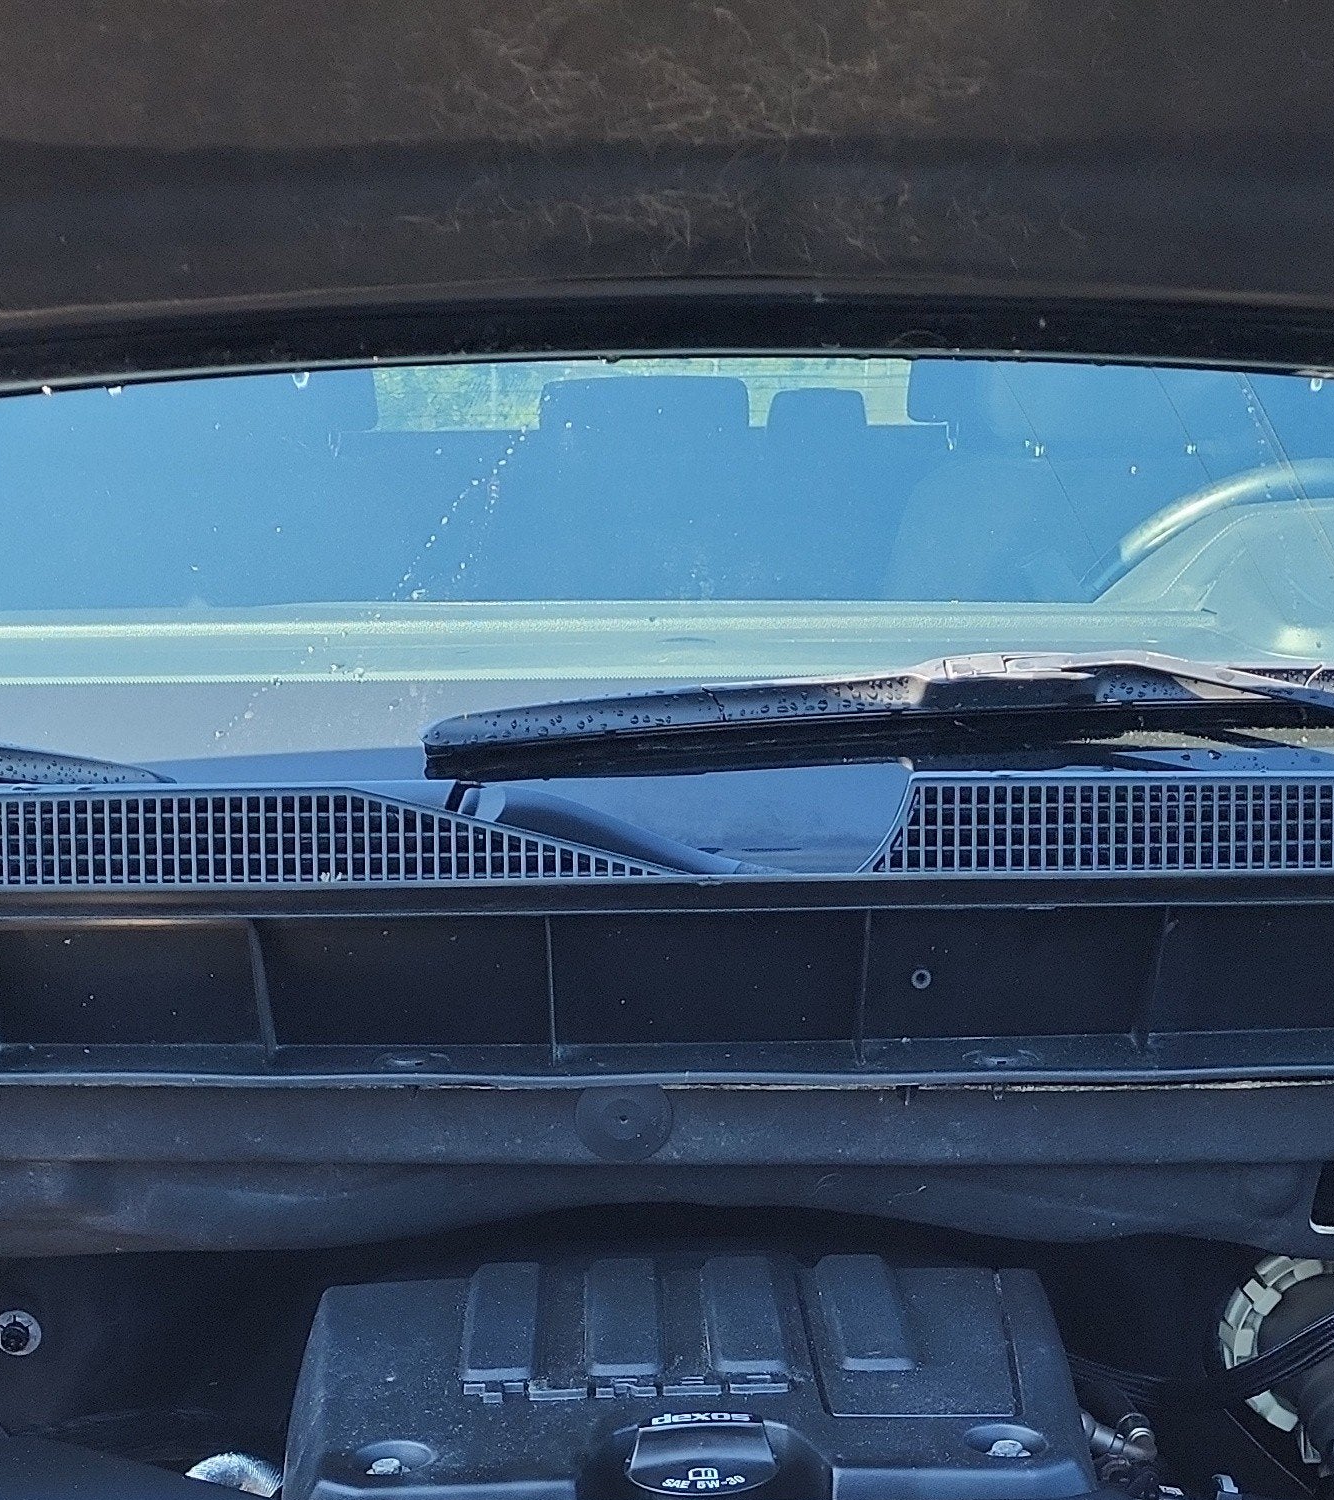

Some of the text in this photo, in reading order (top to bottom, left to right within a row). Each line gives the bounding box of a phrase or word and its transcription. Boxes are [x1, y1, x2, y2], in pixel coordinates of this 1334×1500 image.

[652, 1412, 750, 1425] dexos
[662, 1476, 746, 1489] SAE 5W-30
